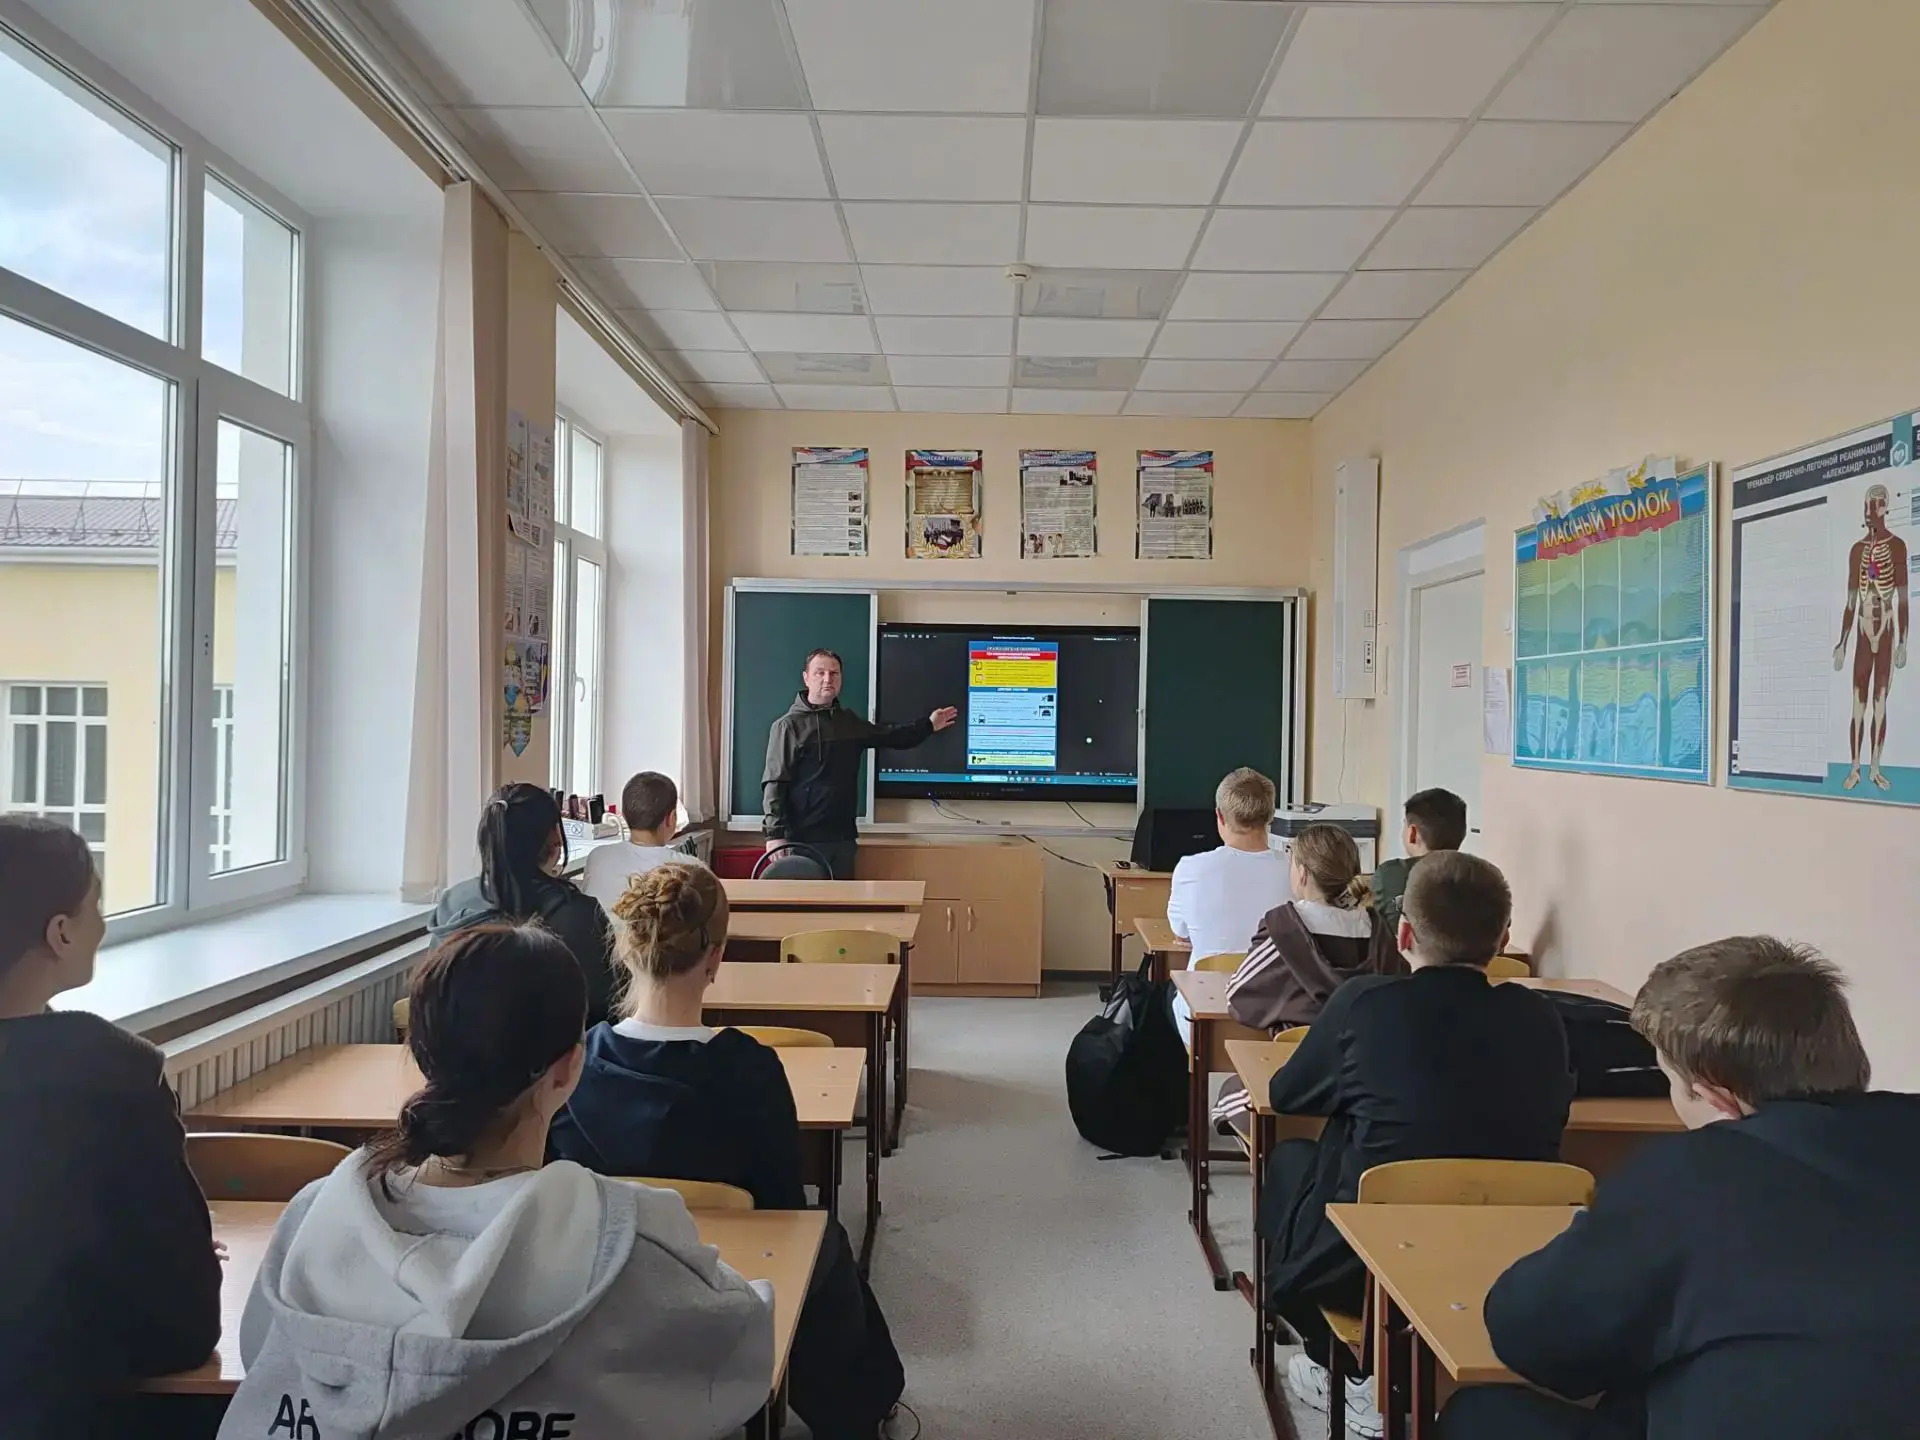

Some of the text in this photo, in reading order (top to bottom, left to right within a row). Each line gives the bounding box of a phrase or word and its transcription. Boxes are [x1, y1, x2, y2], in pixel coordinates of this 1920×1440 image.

[1839, 440, 1887, 463] РЕАНИМАЦИИ
[1543, 488, 1673, 549] КЛАССНЫЙ УГОЛОК
